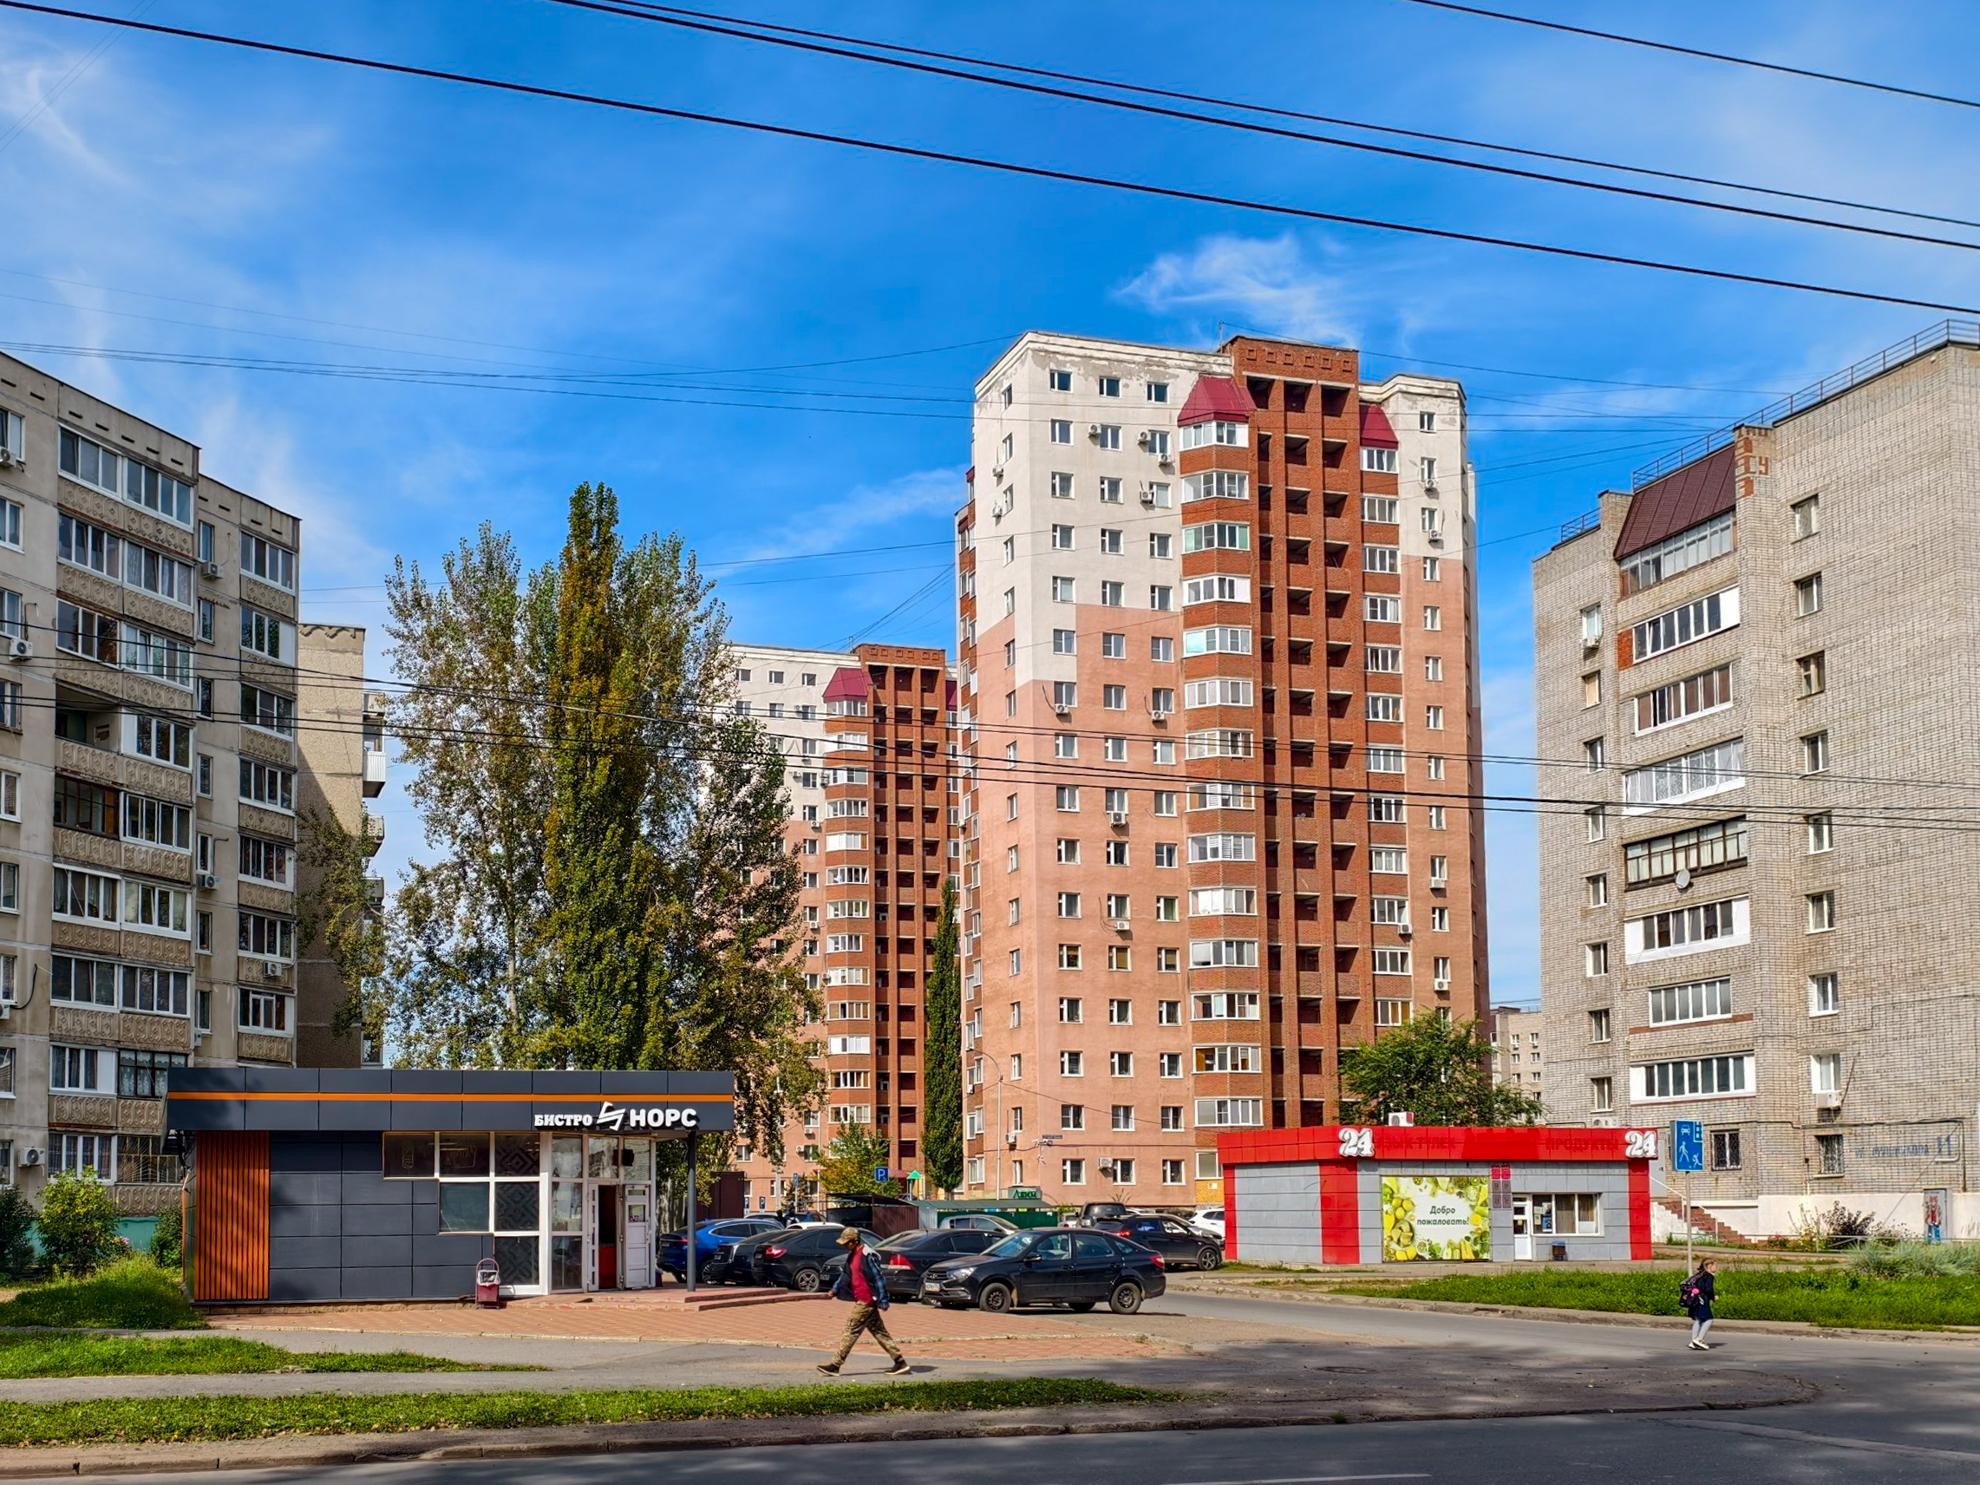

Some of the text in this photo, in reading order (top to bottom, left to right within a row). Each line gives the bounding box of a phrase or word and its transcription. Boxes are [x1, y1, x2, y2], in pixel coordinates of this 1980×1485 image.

[534, 1114, 593, 1127] БИСТРО
[629, 1108, 697, 1127] НОРС
[1339, 1128, 1374, 1157] 24
[1625, 1131, 1657, 1158] 24
[1430, 1205, 1455, 1215] Добро
[1417, 1217, 1469, 1226] пожаловать!
